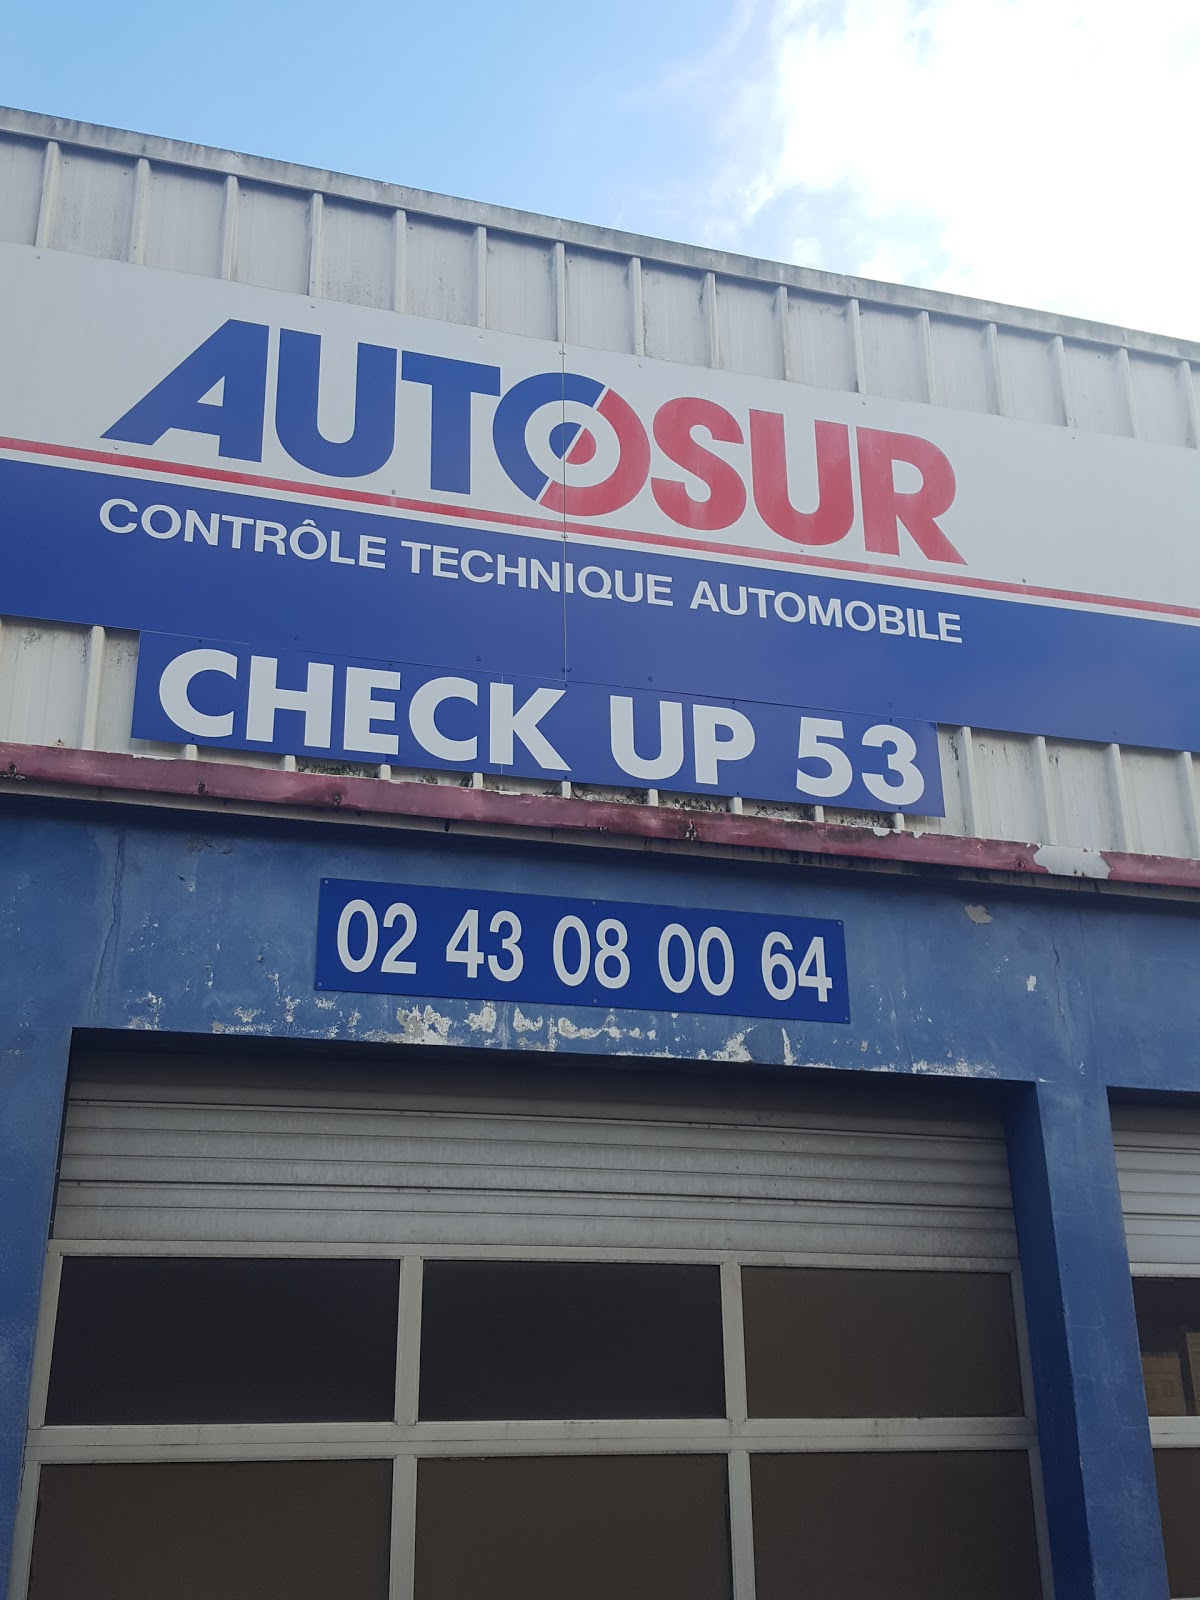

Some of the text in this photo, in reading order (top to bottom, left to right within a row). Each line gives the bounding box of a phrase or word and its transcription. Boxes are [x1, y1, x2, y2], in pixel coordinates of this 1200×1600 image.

[101, 319, 966, 566] AUTOSUR
[99, 498, 963, 644] CONTRÔLE TECHNIQUE AUTOMOBILE
[158, 648, 926, 808] CHECK UP 53
[336, 899, 833, 1004] 02 43 08 00 64
